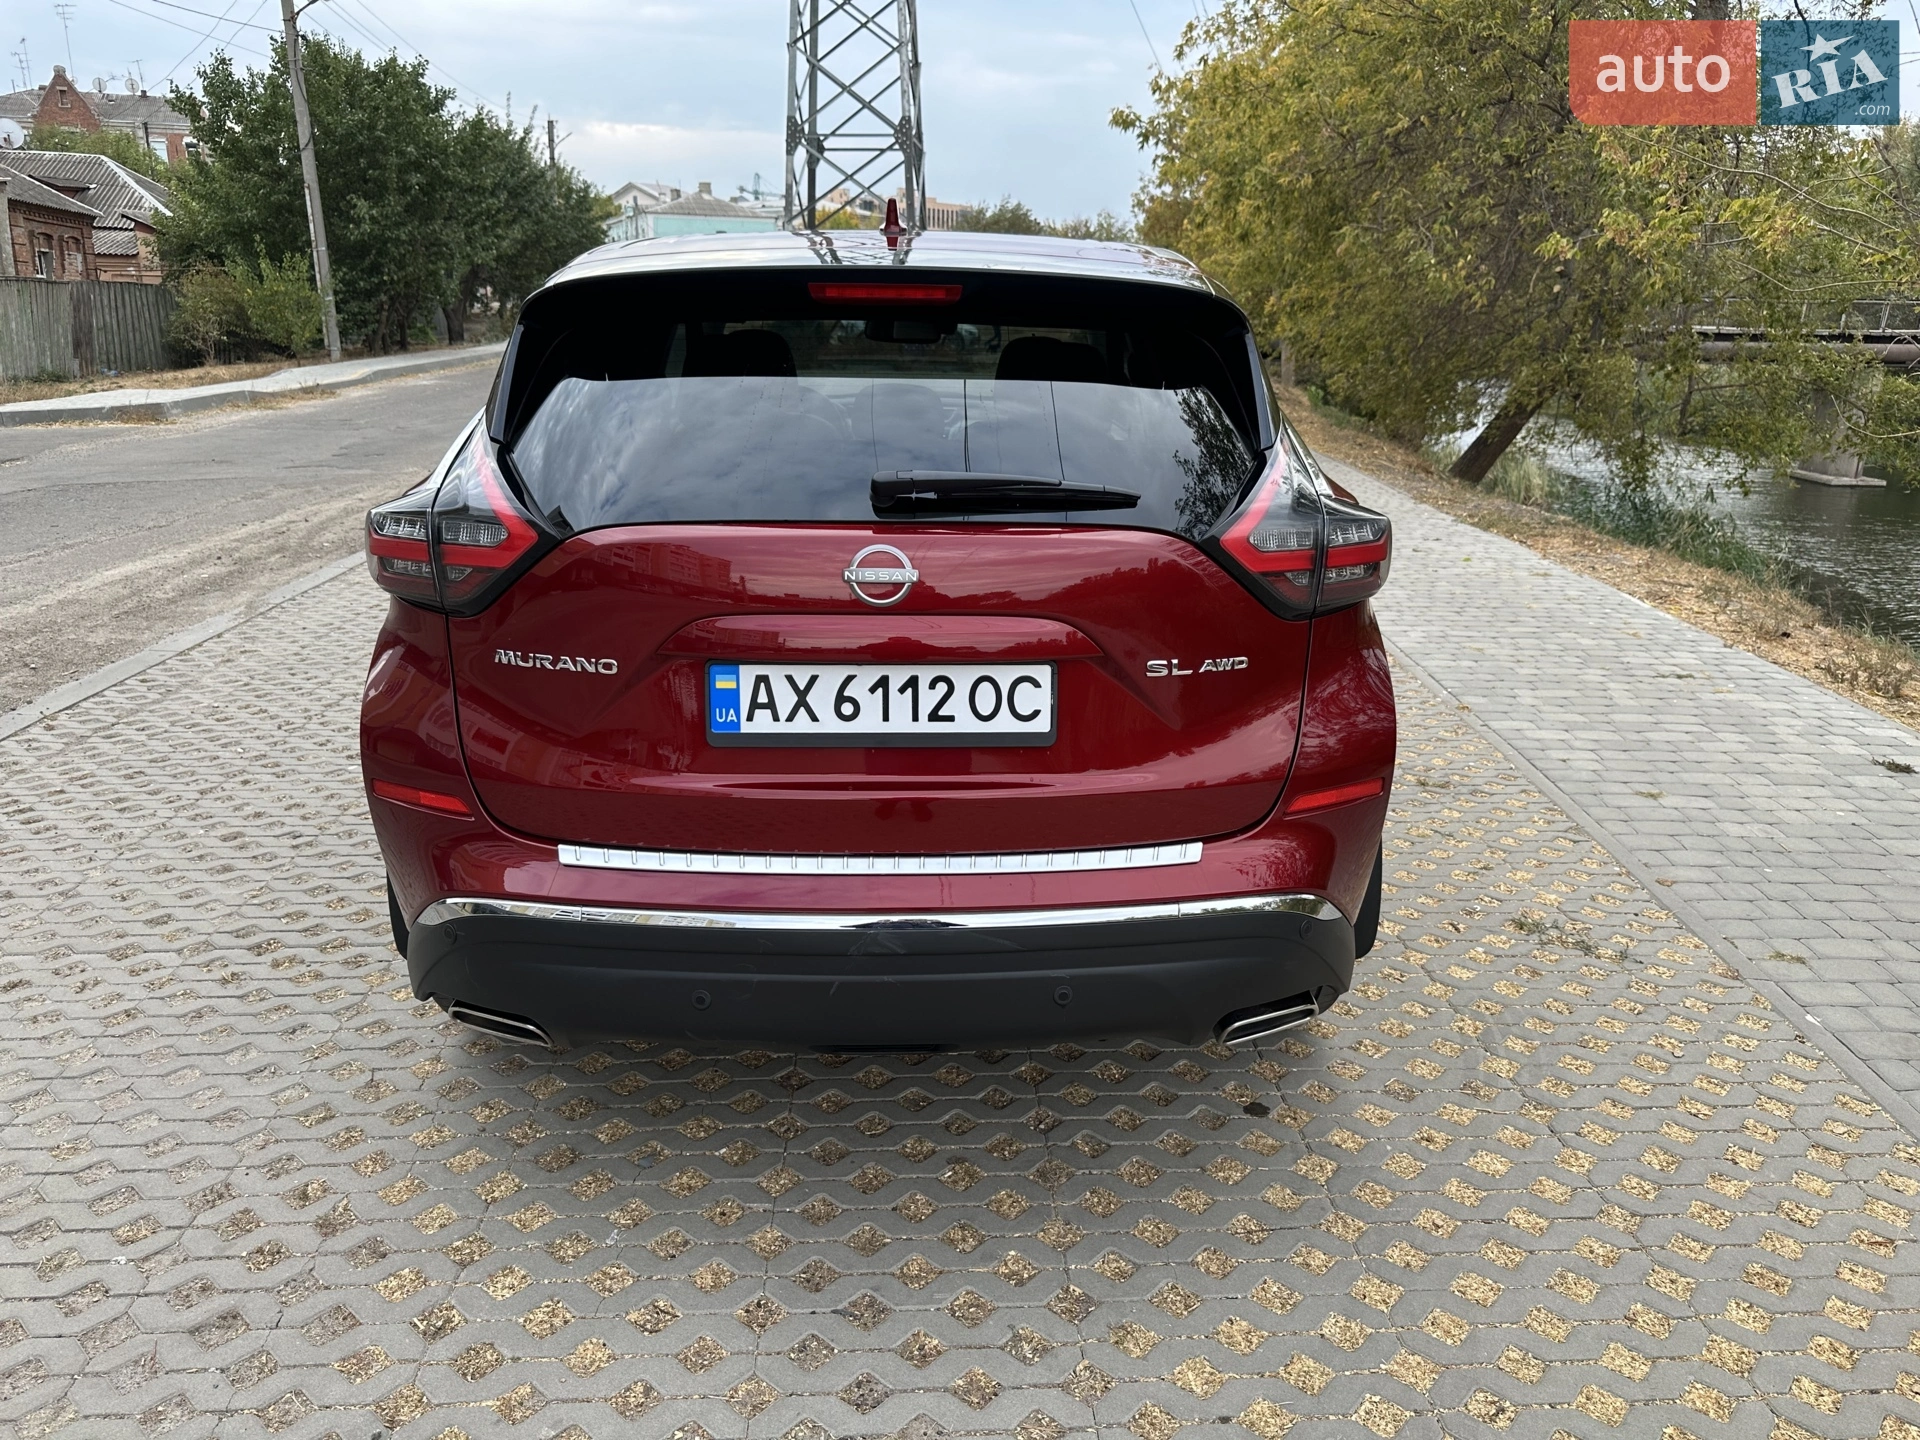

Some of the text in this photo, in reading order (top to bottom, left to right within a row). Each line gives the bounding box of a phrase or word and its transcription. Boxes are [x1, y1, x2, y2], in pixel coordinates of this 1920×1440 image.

[844, 571, 917, 581] NISSAN
[494, 649, 618, 675] MURANO
[1145, 656, 1249, 677] SL AWD
[746, 674, 1043, 722] AX 6112 OC
[716, 708, 738, 722] UA
